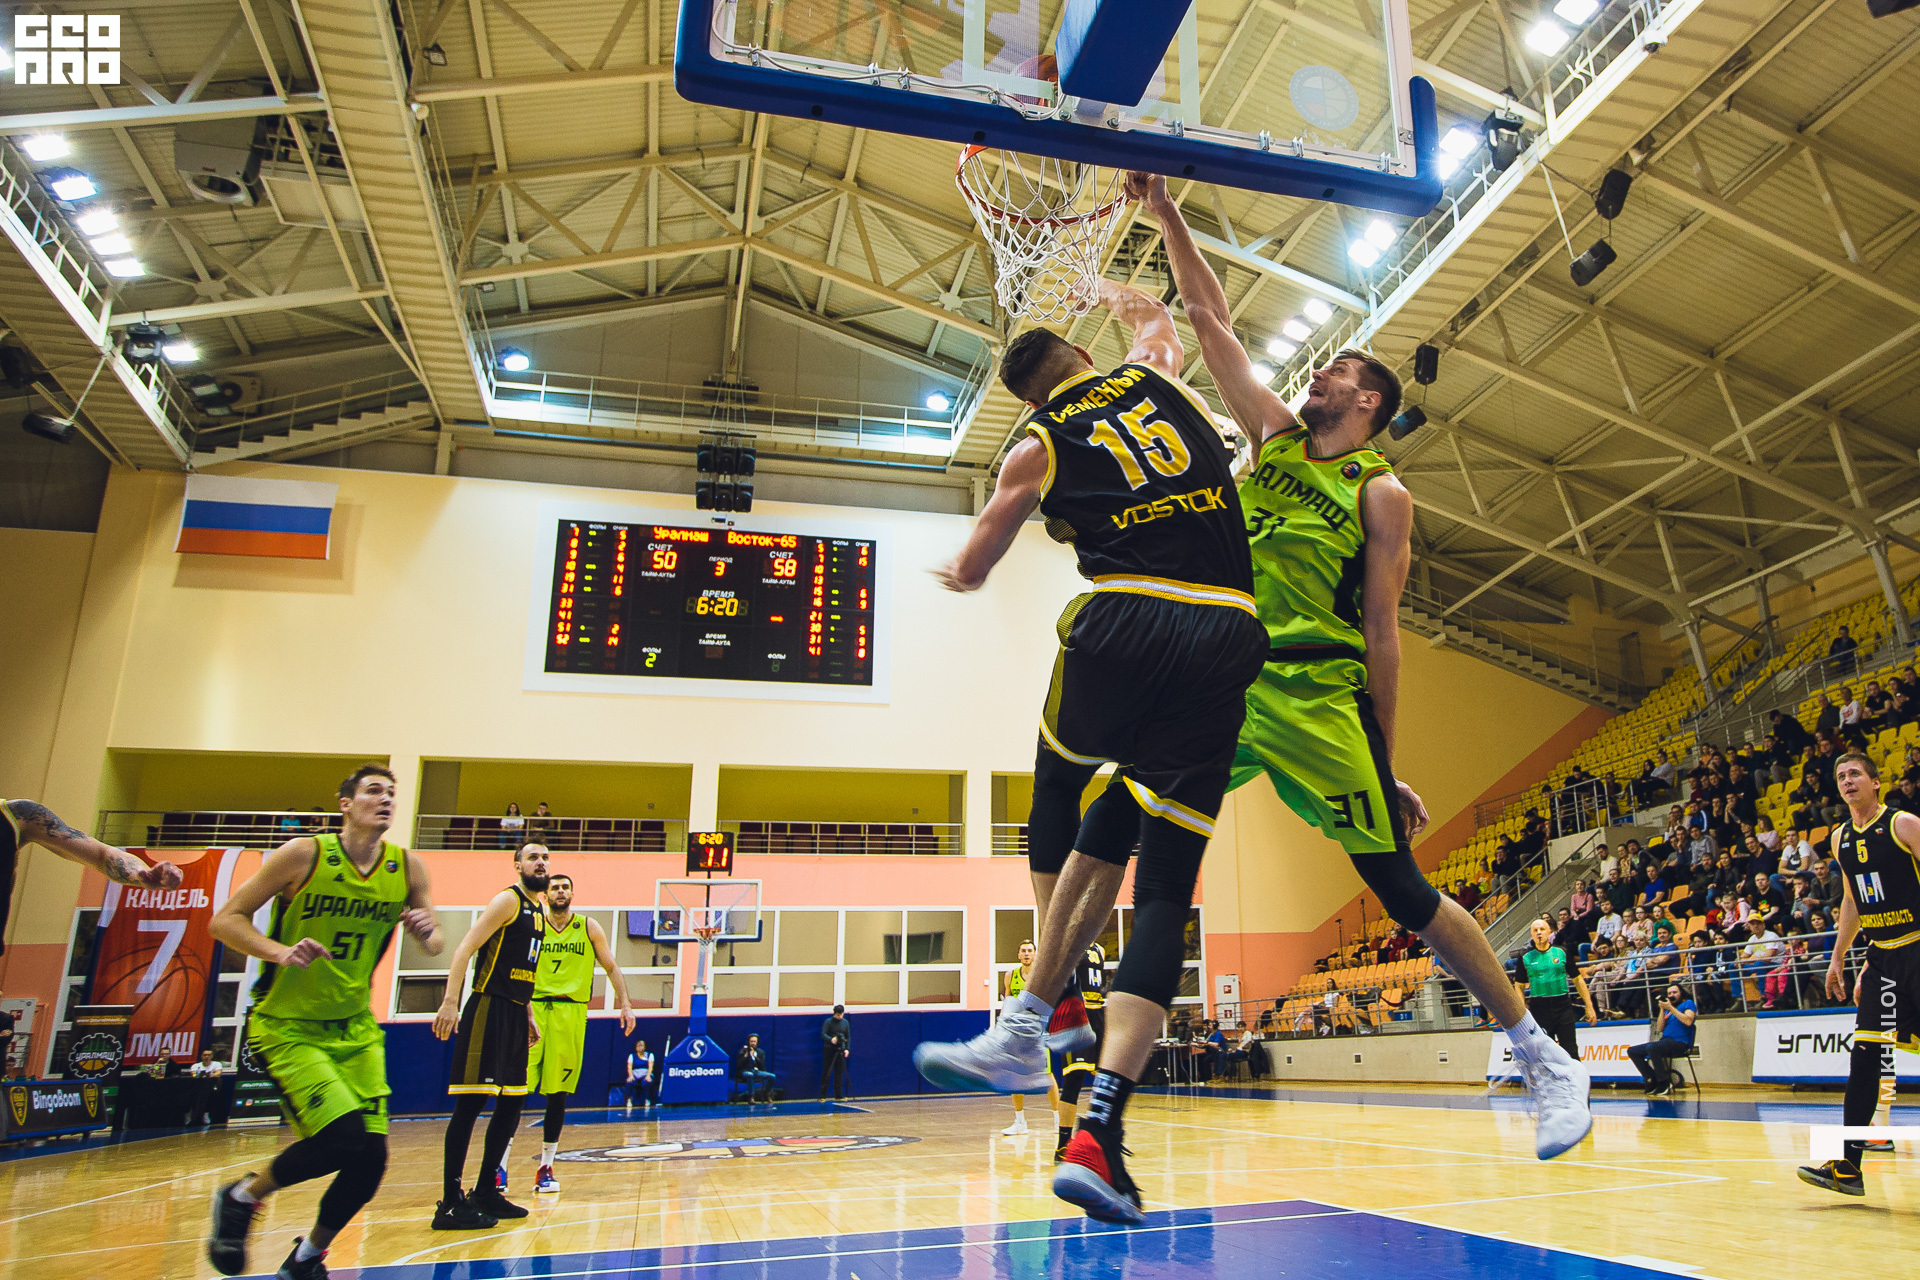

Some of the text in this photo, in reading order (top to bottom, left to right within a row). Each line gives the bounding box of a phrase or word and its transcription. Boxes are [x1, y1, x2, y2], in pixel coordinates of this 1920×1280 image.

[1086, 397, 1191, 491] 15
[1250, 461, 1350, 531] АЛМАШ
[1111, 486, 1228, 529] VOSTOK
[1247, 506, 1288, 540] 31
[647, 543, 673, 551] СЧЕТ
[727, 530, 797, 548] Восток-65
[652, 550, 678, 570] 50
[769, 551, 794, 559] СЧЕТ
[714, 560, 726, 577] 3
[773, 558, 797, 577] 58
[612, 574, 624, 585] 11
[702, 589, 735, 598] ВРЕМЯ
[558, 610, 572, 620] 41
[696, 596, 739, 617] 6:20
[809, 610, 823, 621] 21
[557, 621, 571, 633] 51
[611, 623, 620, 635] 2
[555, 633, 570, 645] 52
[809, 633, 822, 645] 31
[808, 645, 822, 656] 41
[645, 652, 657, 668] 2
[1324, 789, 1376, 829] 31
[698, 832, 724, 845] 6:20
[706, 846, 729, 868] 11
[1856, 839, 1868, 863] 5
[125, 888, 209, 910] КАНДЕЛЬ
[301, 892, 392, 922] УРАЛМА
[331, 931, 368, 960] 51
[540, 942, 585, 956] РАЛМАШ
[135, 919, 188, 994] 7
[552, 960, 562, 974] 7
[124, 1031, 196, 1058] ЛМАШ
[1777, 1033, 1854, 1054] УГМК
[75, 1052, 115, 1062] УРАЛМАШ
[562, 1068, 573, 1082] 7
[669, 1067, 724, 1078] BingoBoom
[32, 1089, 81, 1113] BingoBoom
